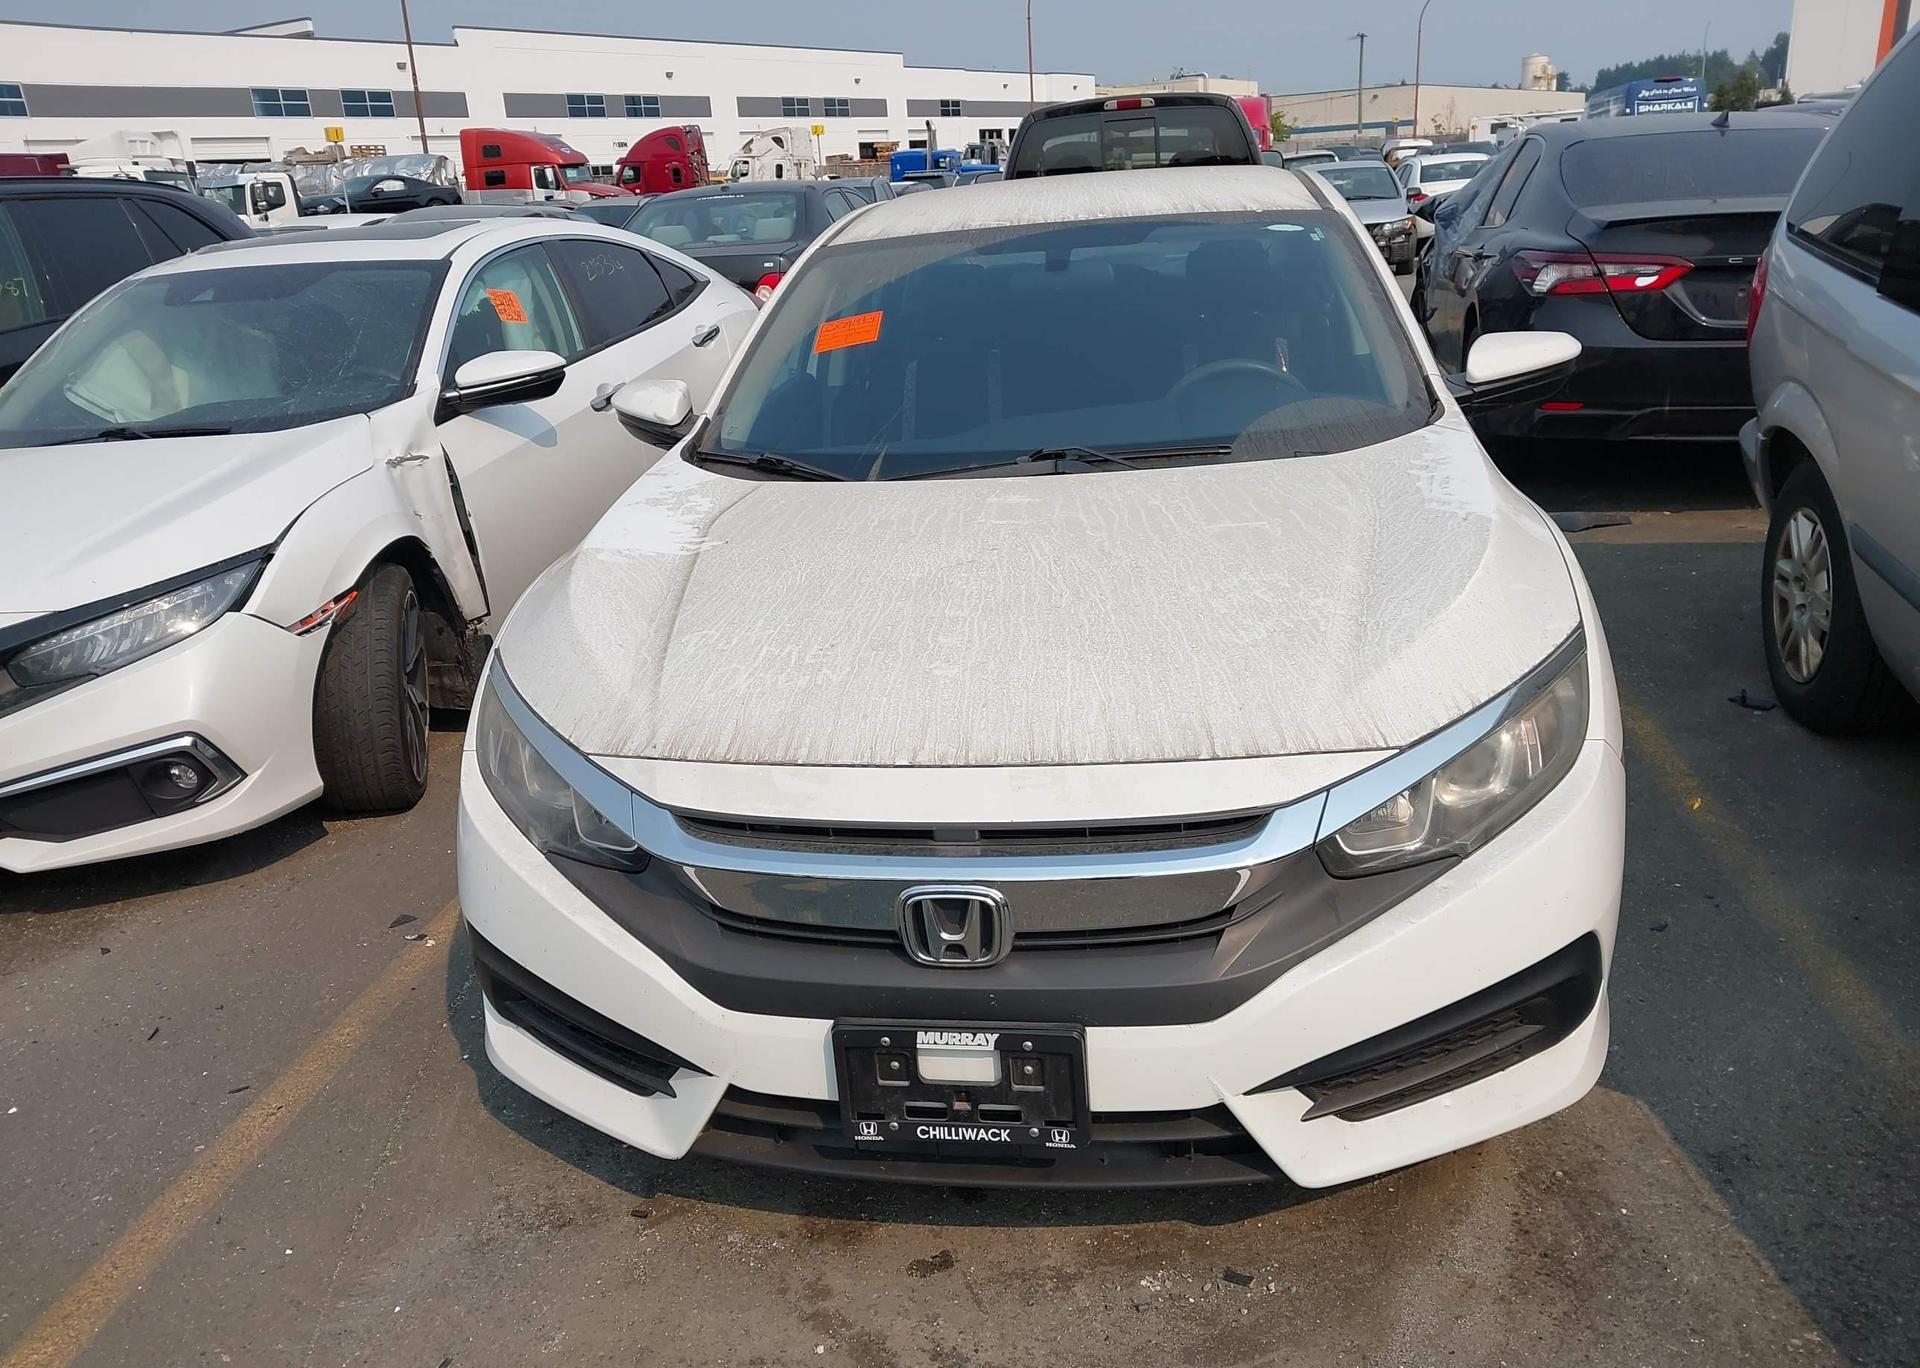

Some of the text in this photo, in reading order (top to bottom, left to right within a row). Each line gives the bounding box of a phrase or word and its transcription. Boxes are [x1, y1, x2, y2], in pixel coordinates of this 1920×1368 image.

[1638, 102, 1694, 112] SHARKALE
[916, 1031, 1000, 1047] MURRAY
[916, 1125, 1012, 1142] CHILLIWACK
